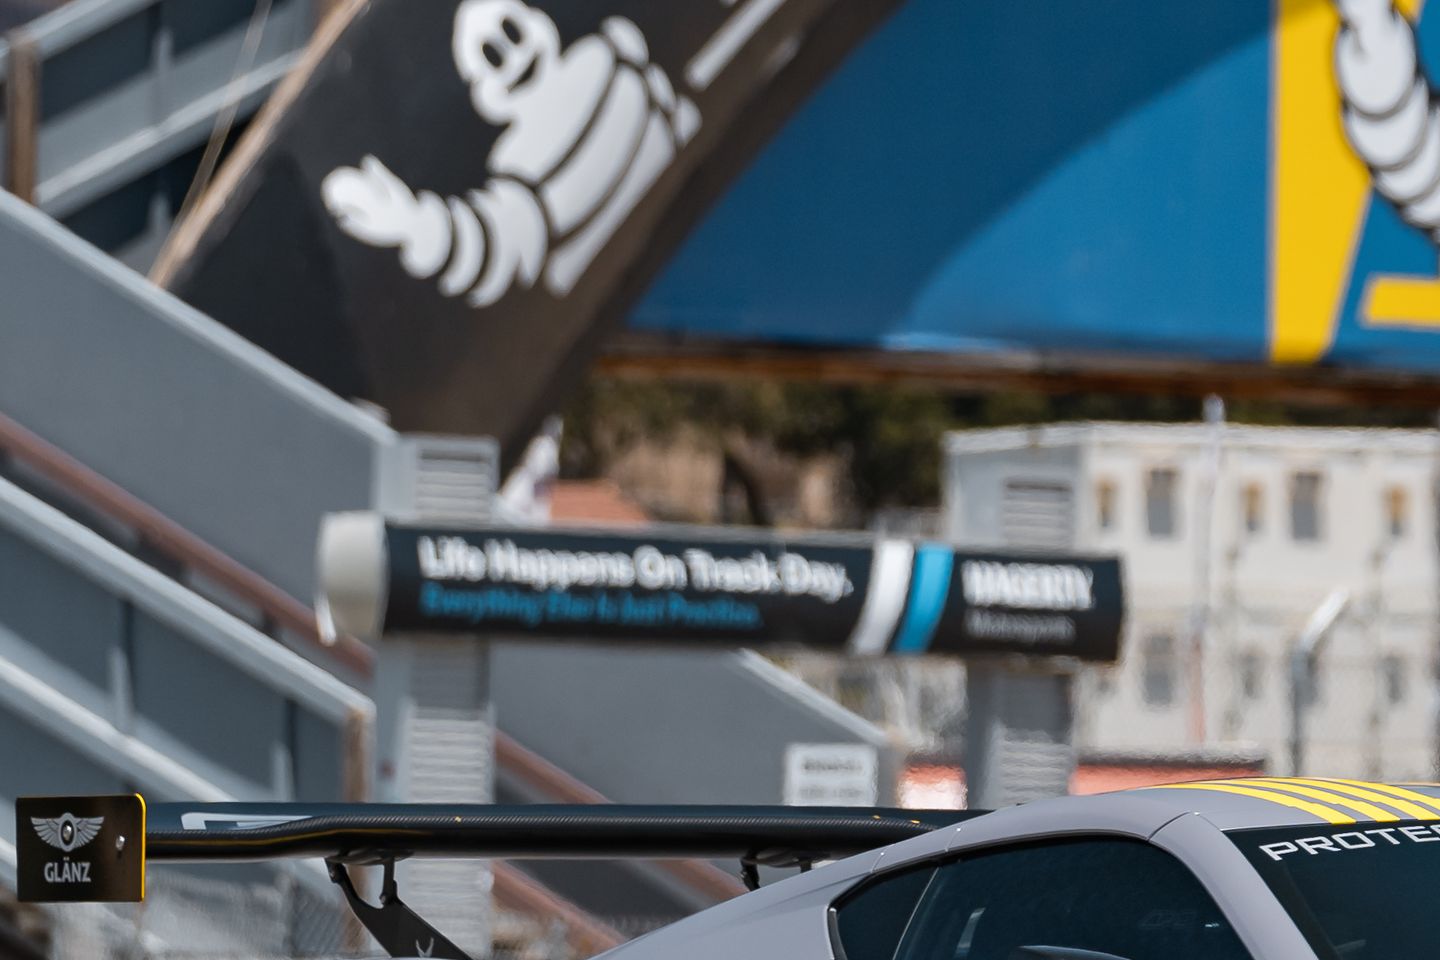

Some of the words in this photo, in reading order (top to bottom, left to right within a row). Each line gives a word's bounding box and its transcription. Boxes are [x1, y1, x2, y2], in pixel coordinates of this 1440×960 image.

[417, 535, 486, 581] Life
[484, 538, 635, 592] Happens
[634, 545, 688, 591] On
[683, 548, 781, 593] Track
[44, 856, 92, 883] GLÄNZ
